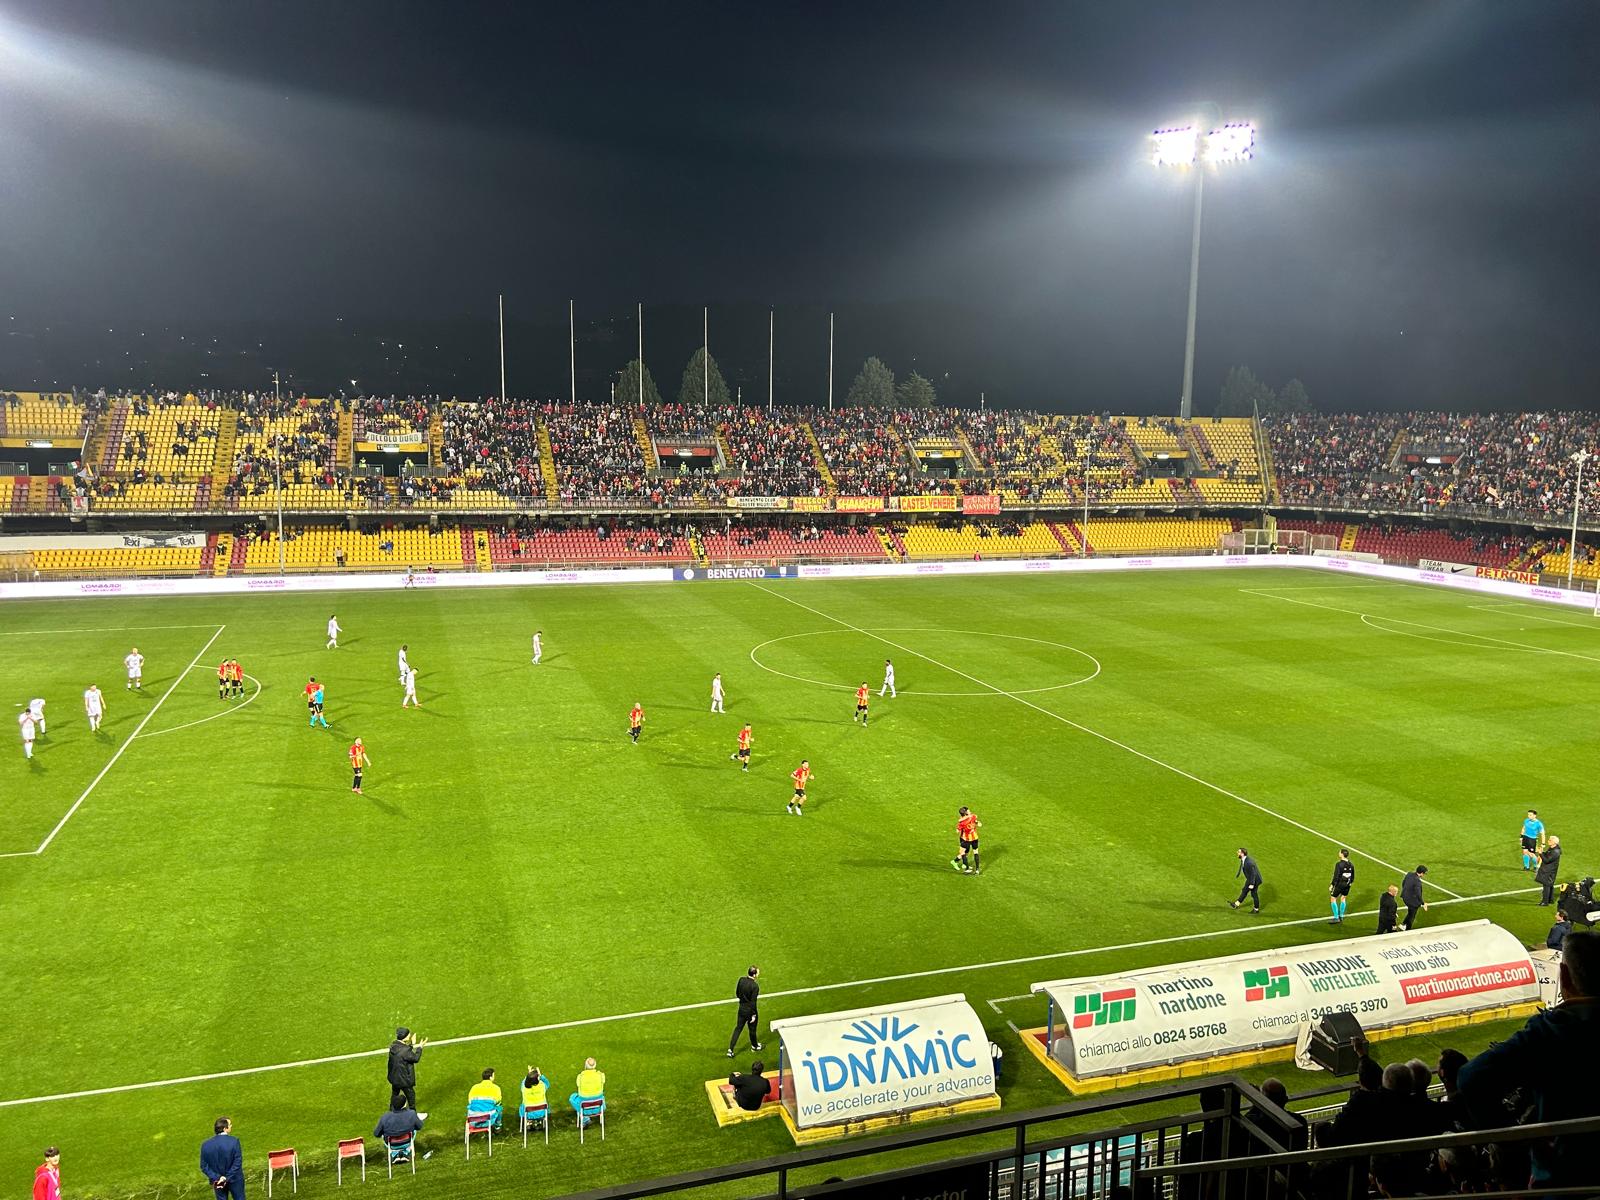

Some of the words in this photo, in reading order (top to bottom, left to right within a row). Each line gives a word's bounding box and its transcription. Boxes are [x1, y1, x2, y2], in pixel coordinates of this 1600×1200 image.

[901, 497, 956, 510] CASTELVENERE
[122, 536, 141, 547] Texi
[177, 535, 196, 546] Texi
[707, 567, 766, 579] BENEVENTO
[1475, 566, 1539, 585] PETRONE
[1378, 946, 1411, 961] visita
[1410, 944, 1422, 956] il
[1420, 940, 1459, 954] nostro
[1297, 955, 1371, 977] NARDONE
[1390, 959, 1427, 975] nuovo
[1427, 955, 1450, 969] sito
[1147, 975, 1214, 996] martino
[1308, 969, 1381, 993] HOTELLERIE
[1405, 966, 1531, 999] martinonardone.com
[1158, 993, 1228, 1016] nardone
[1252, 1010, 1299, 1030] chiamaci
[1300, 1009, 1310, 1022] al
[1360, 997, 1389, 1014] 3970
[1079, 1037, 1130, 1059] chiamaci
[1132, 1034, 1152, 1048] allo
[1153, 1028, 1187, 1046] 0824
[1189, 1022, 1228, 1040] 58768
[801, 1103, 823, 1117] we
[827, 1089, 900, 1113] accelerate
[903, 1082, 934, 1103] your
[936, 1074, 993, 1094] advance
